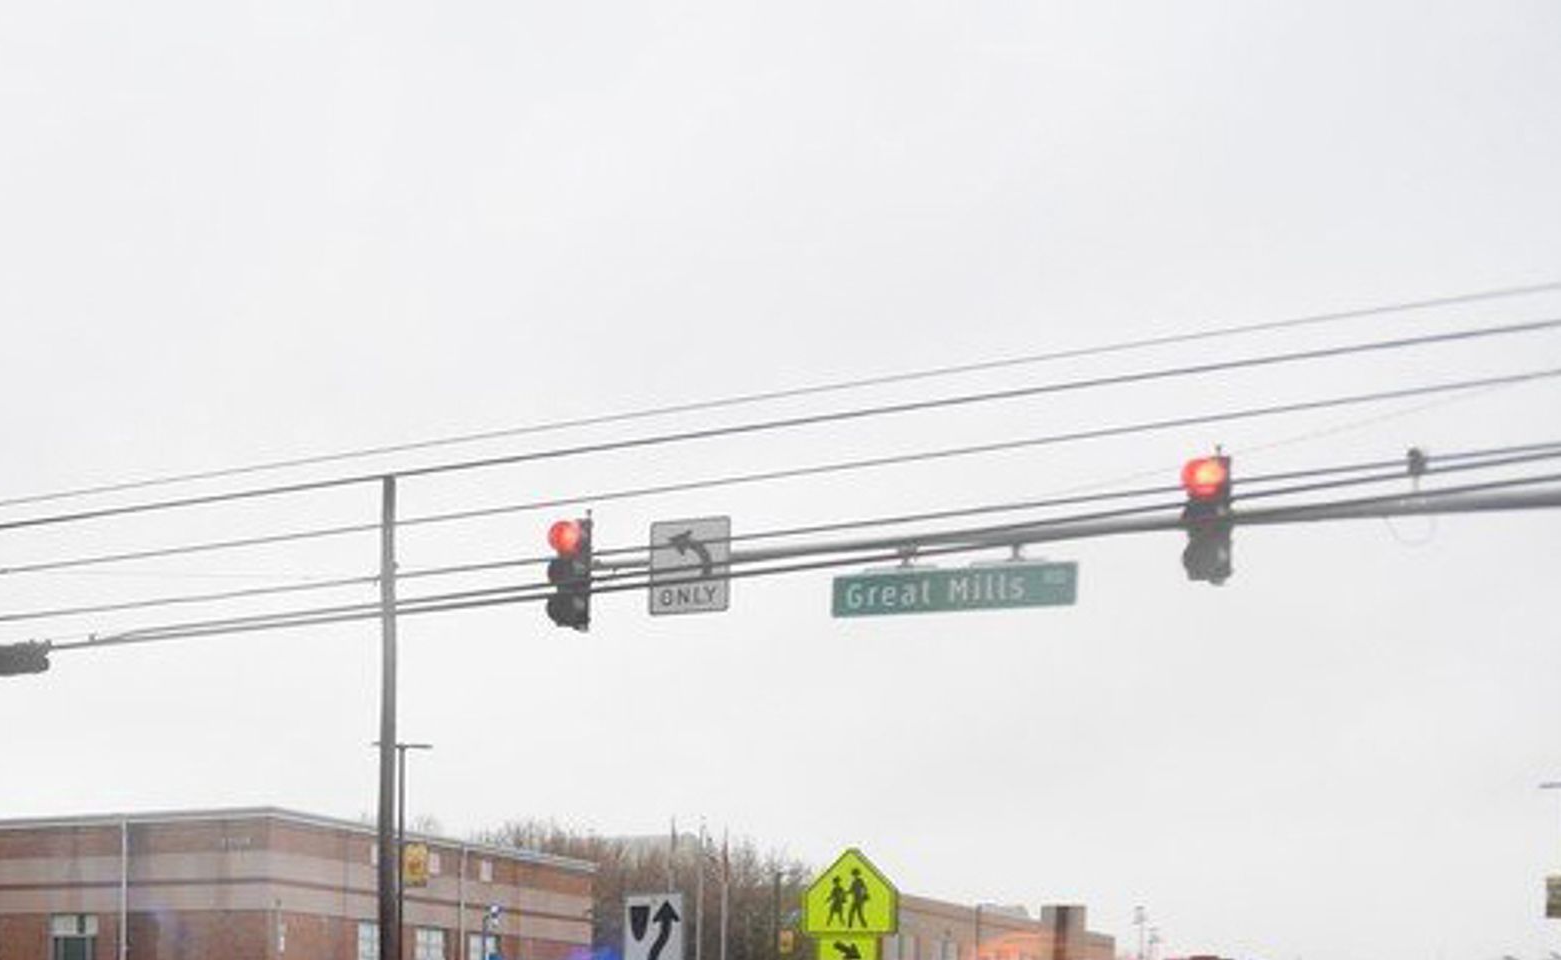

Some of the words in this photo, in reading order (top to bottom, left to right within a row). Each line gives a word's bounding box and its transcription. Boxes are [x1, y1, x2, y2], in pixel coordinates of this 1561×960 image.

[660, 586, 717, 606] ONLY
[846, 579, 930, 609] Great
[949, 574, 1026, 603] Mills
